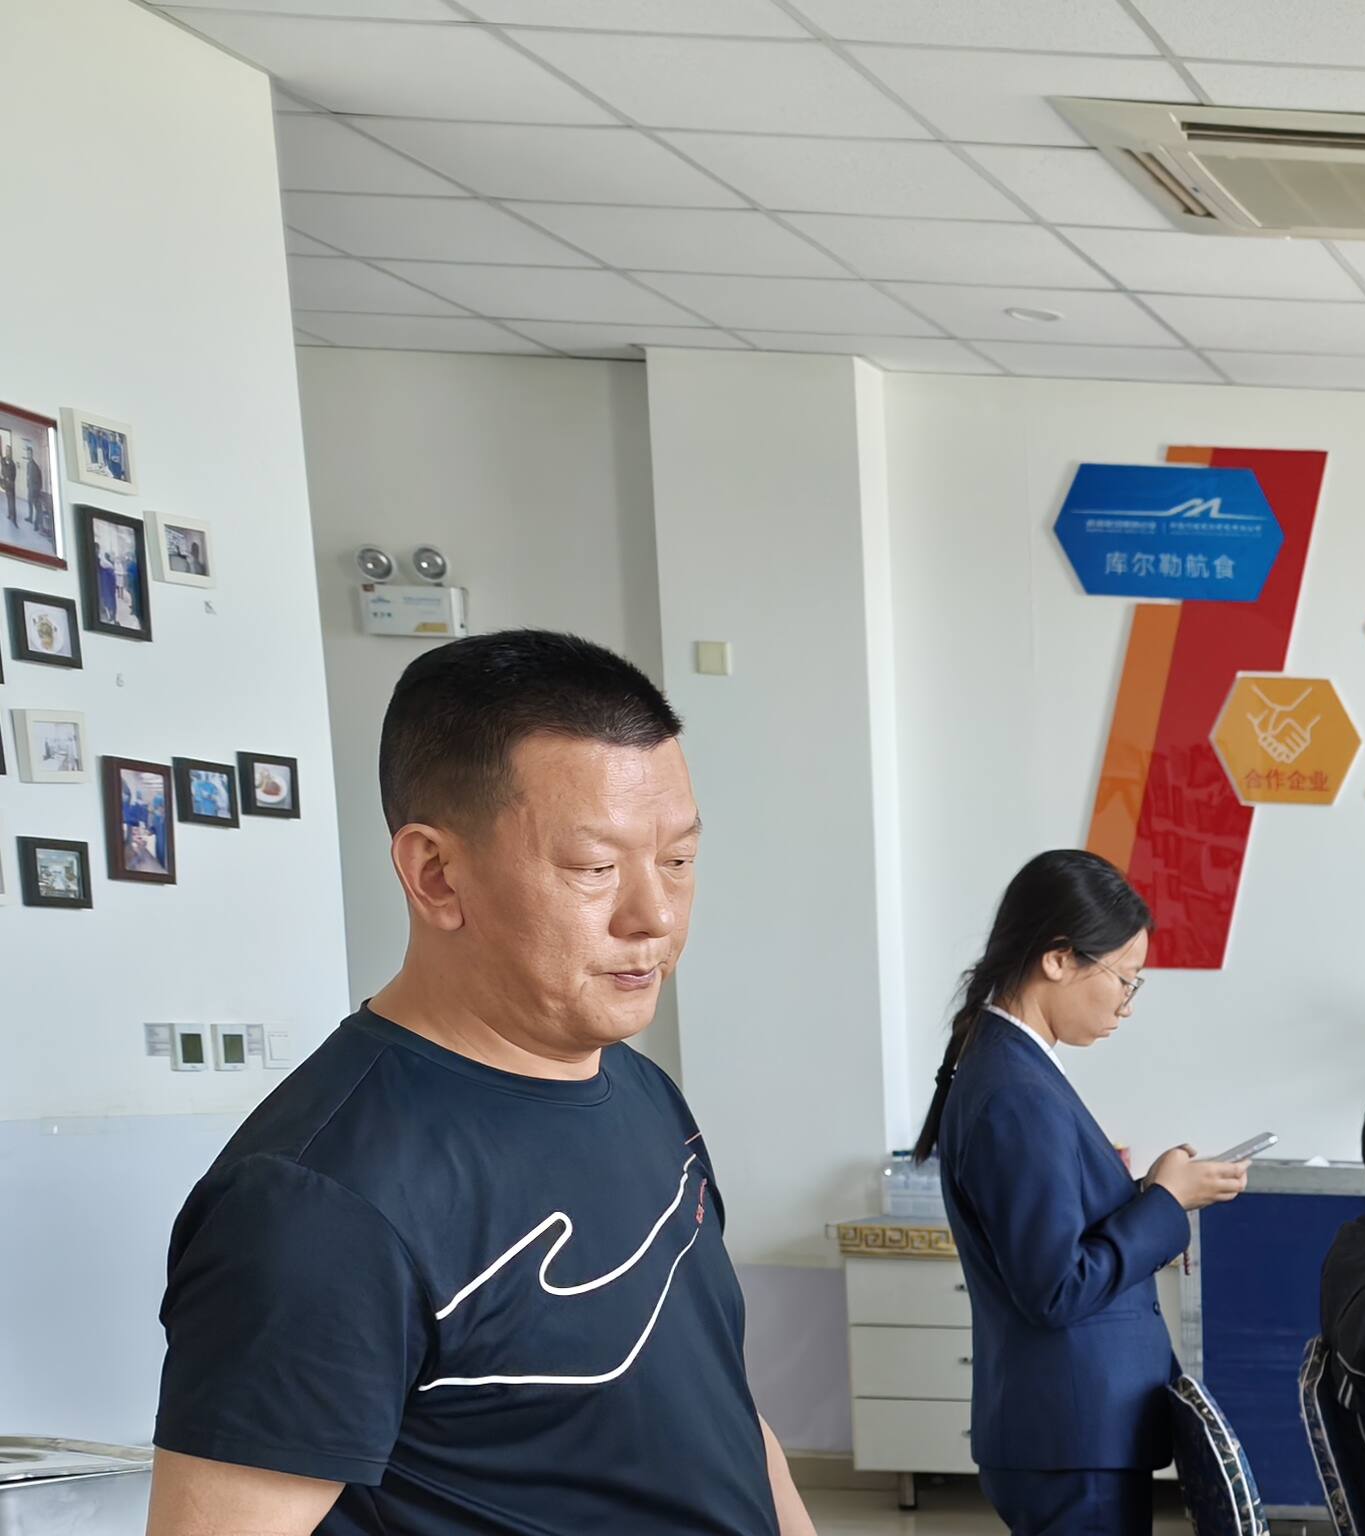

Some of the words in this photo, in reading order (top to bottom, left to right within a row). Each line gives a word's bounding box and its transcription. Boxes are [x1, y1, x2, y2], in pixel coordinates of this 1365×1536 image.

[1105, 551, 1235, 579] 库尔勒航食
[1244, 768, 1330, 794] 合作企业
